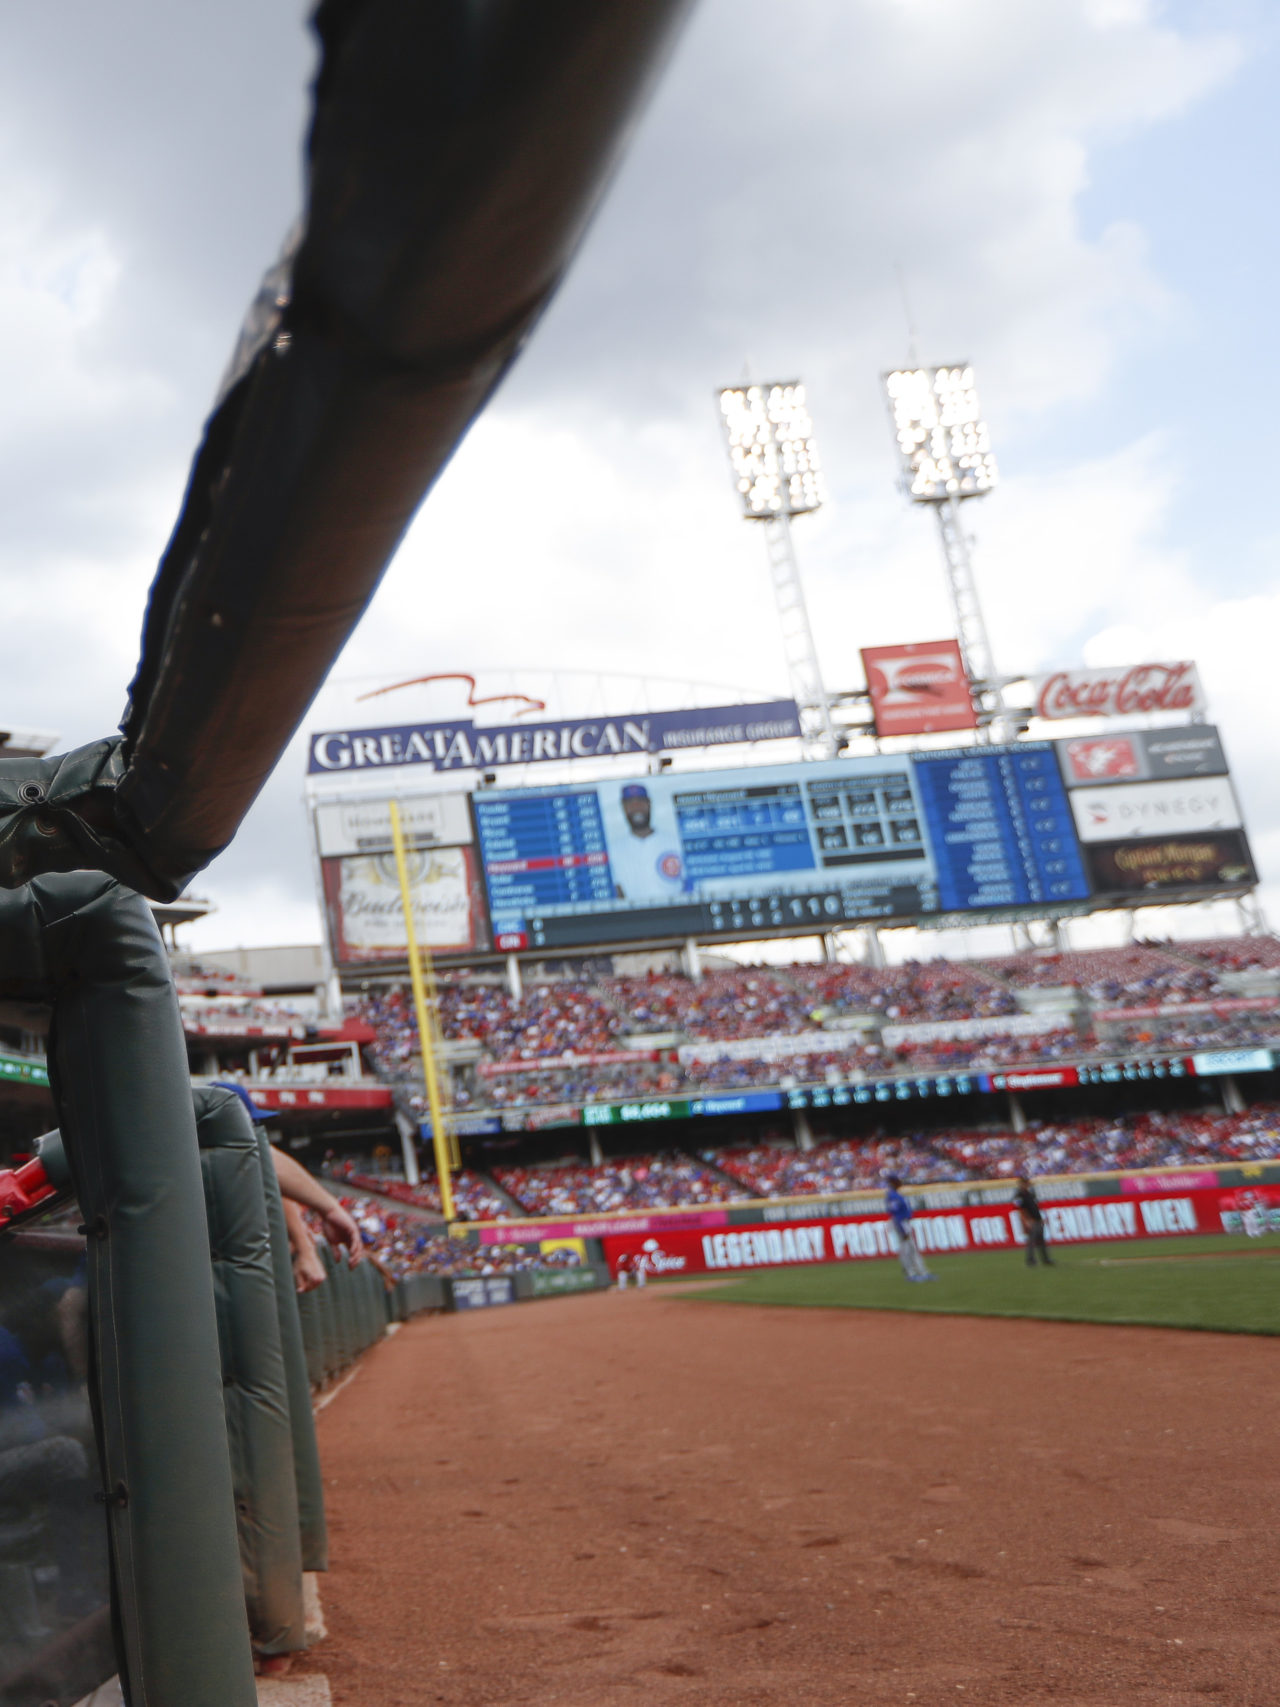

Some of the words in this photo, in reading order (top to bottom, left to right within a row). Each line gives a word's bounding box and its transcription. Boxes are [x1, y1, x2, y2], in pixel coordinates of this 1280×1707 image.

[314, 730, 453, 769] GREAT
[443, 719, 651, 768] AMERICAN
[702, 1226, 825, 1269] LEGENDARY
[830, 1215, 968, 1258] PROTETION
[970, 1216, 1009, 1245] FOR
[1009, 1201, 1137, 1244] LGENDARY
[1139, 1198, 1198, 1234] MEN
